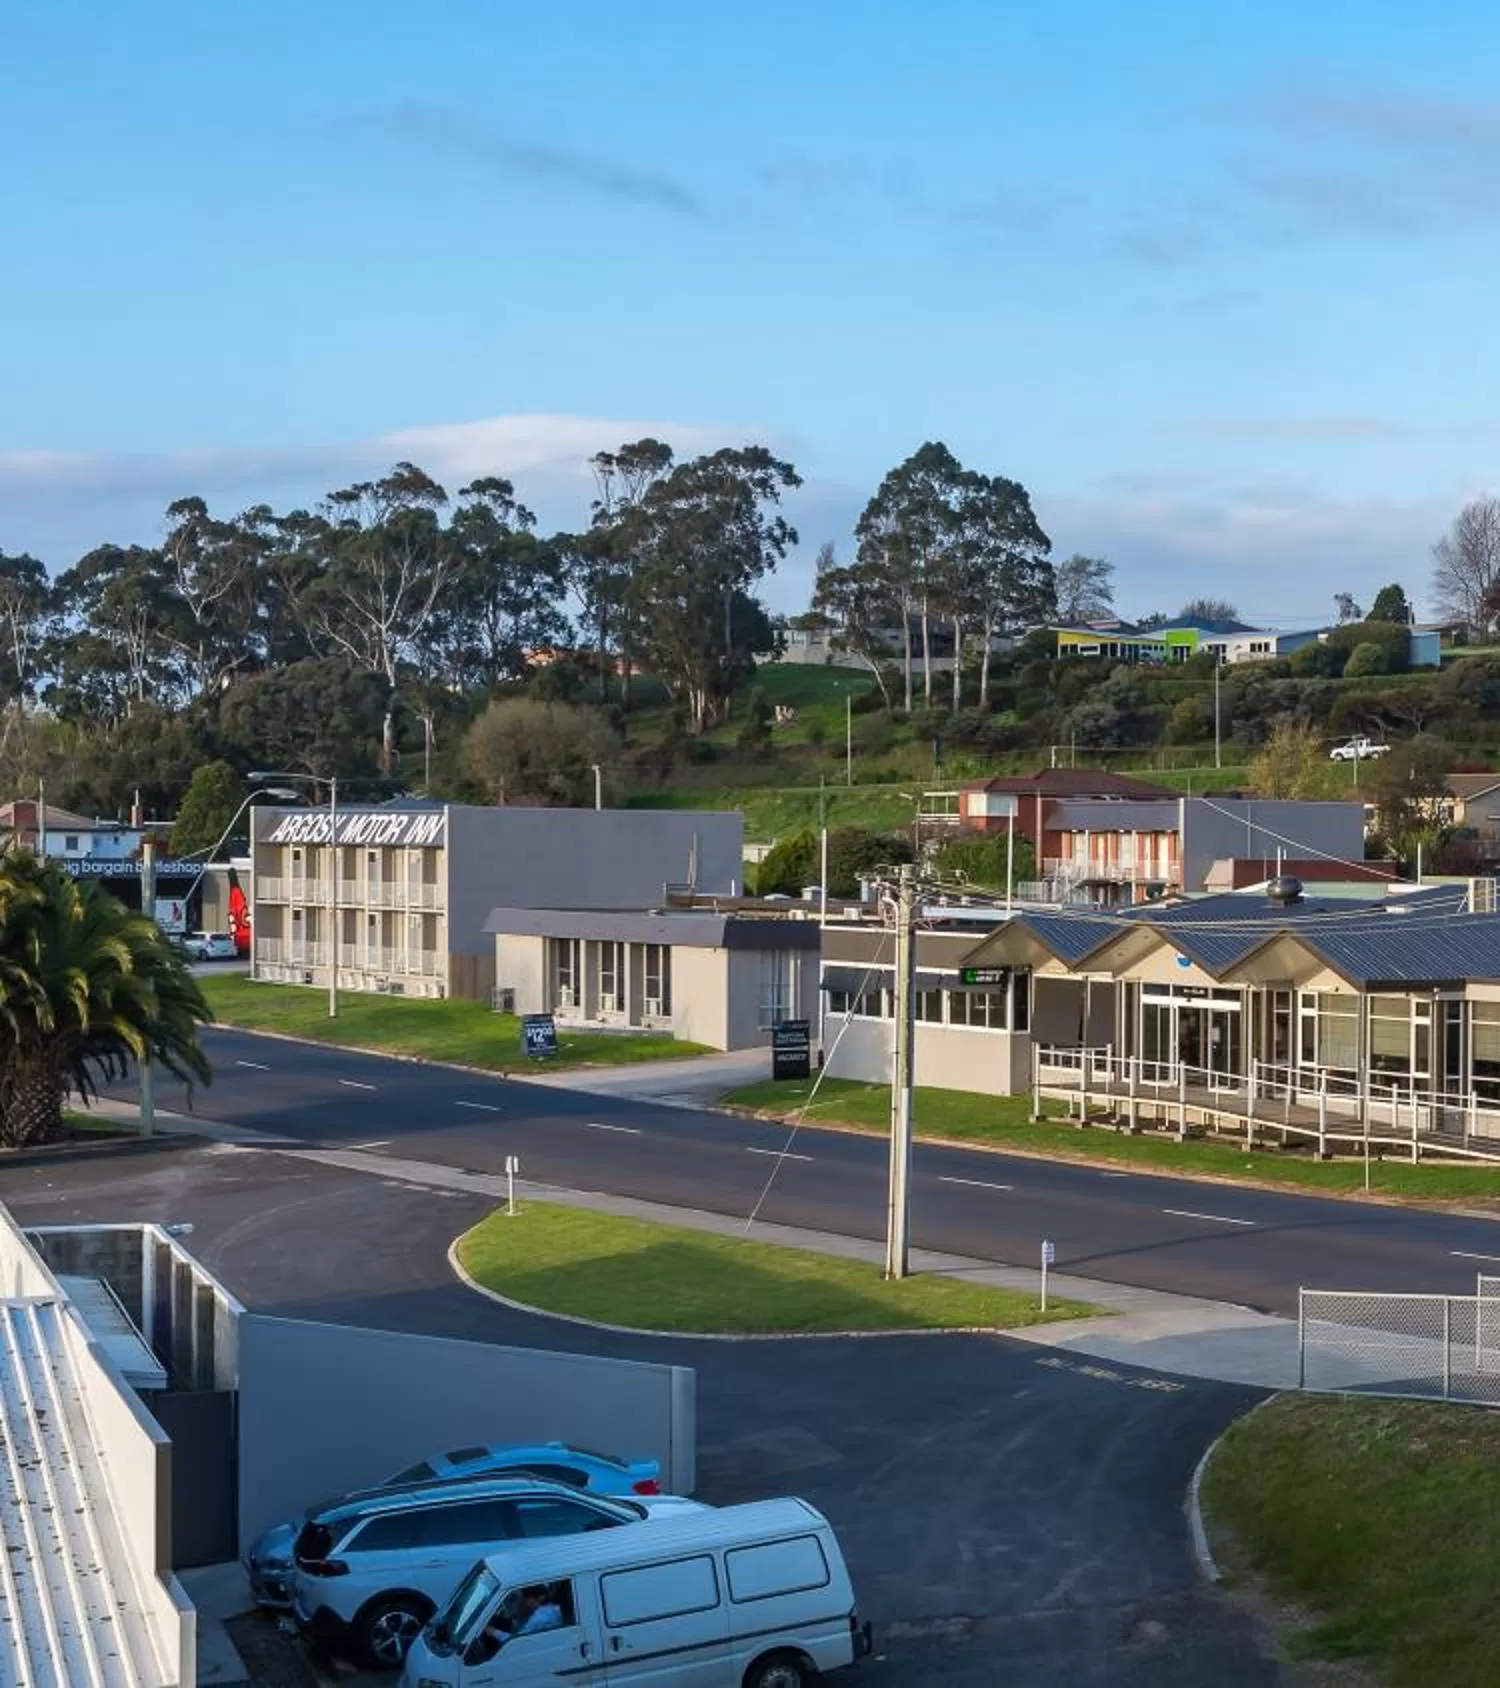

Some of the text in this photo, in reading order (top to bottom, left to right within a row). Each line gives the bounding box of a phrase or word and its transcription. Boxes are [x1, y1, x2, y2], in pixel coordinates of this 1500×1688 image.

[268, 813, 446, 844] ARGOSY MOTOR INN
[82, 860, 133, 876] bargain
